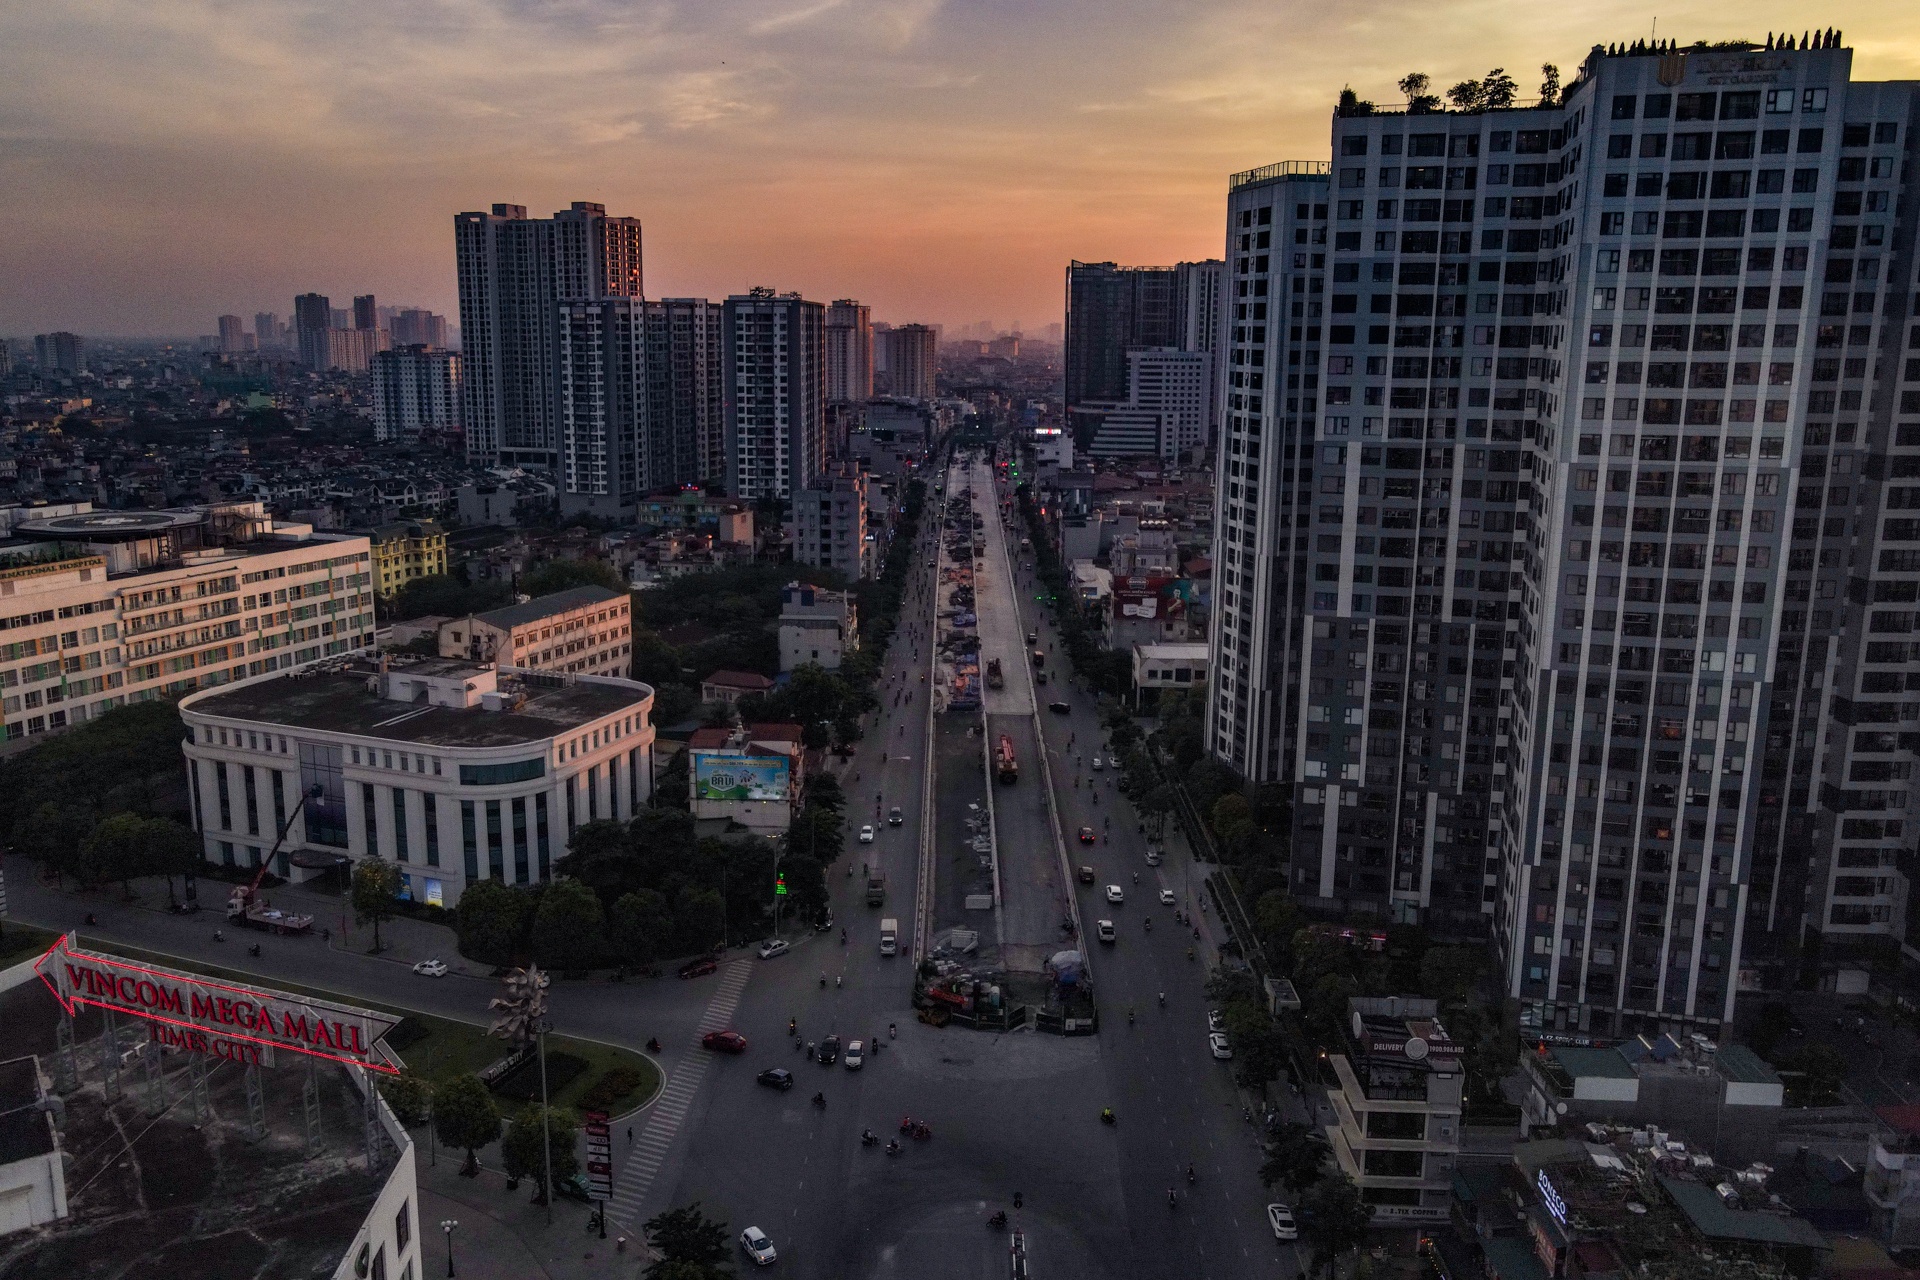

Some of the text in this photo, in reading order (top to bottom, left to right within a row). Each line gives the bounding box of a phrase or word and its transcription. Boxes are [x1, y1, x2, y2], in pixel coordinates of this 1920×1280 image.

[59, 558, 103, 571] HOSPITAL
[65, 963, 369, 1055] VINCOM MEGA MALL
[146, 1021, 263, 1065] TIMES CITY
[1373, 1042, 1404, 1051] DELIVERY
